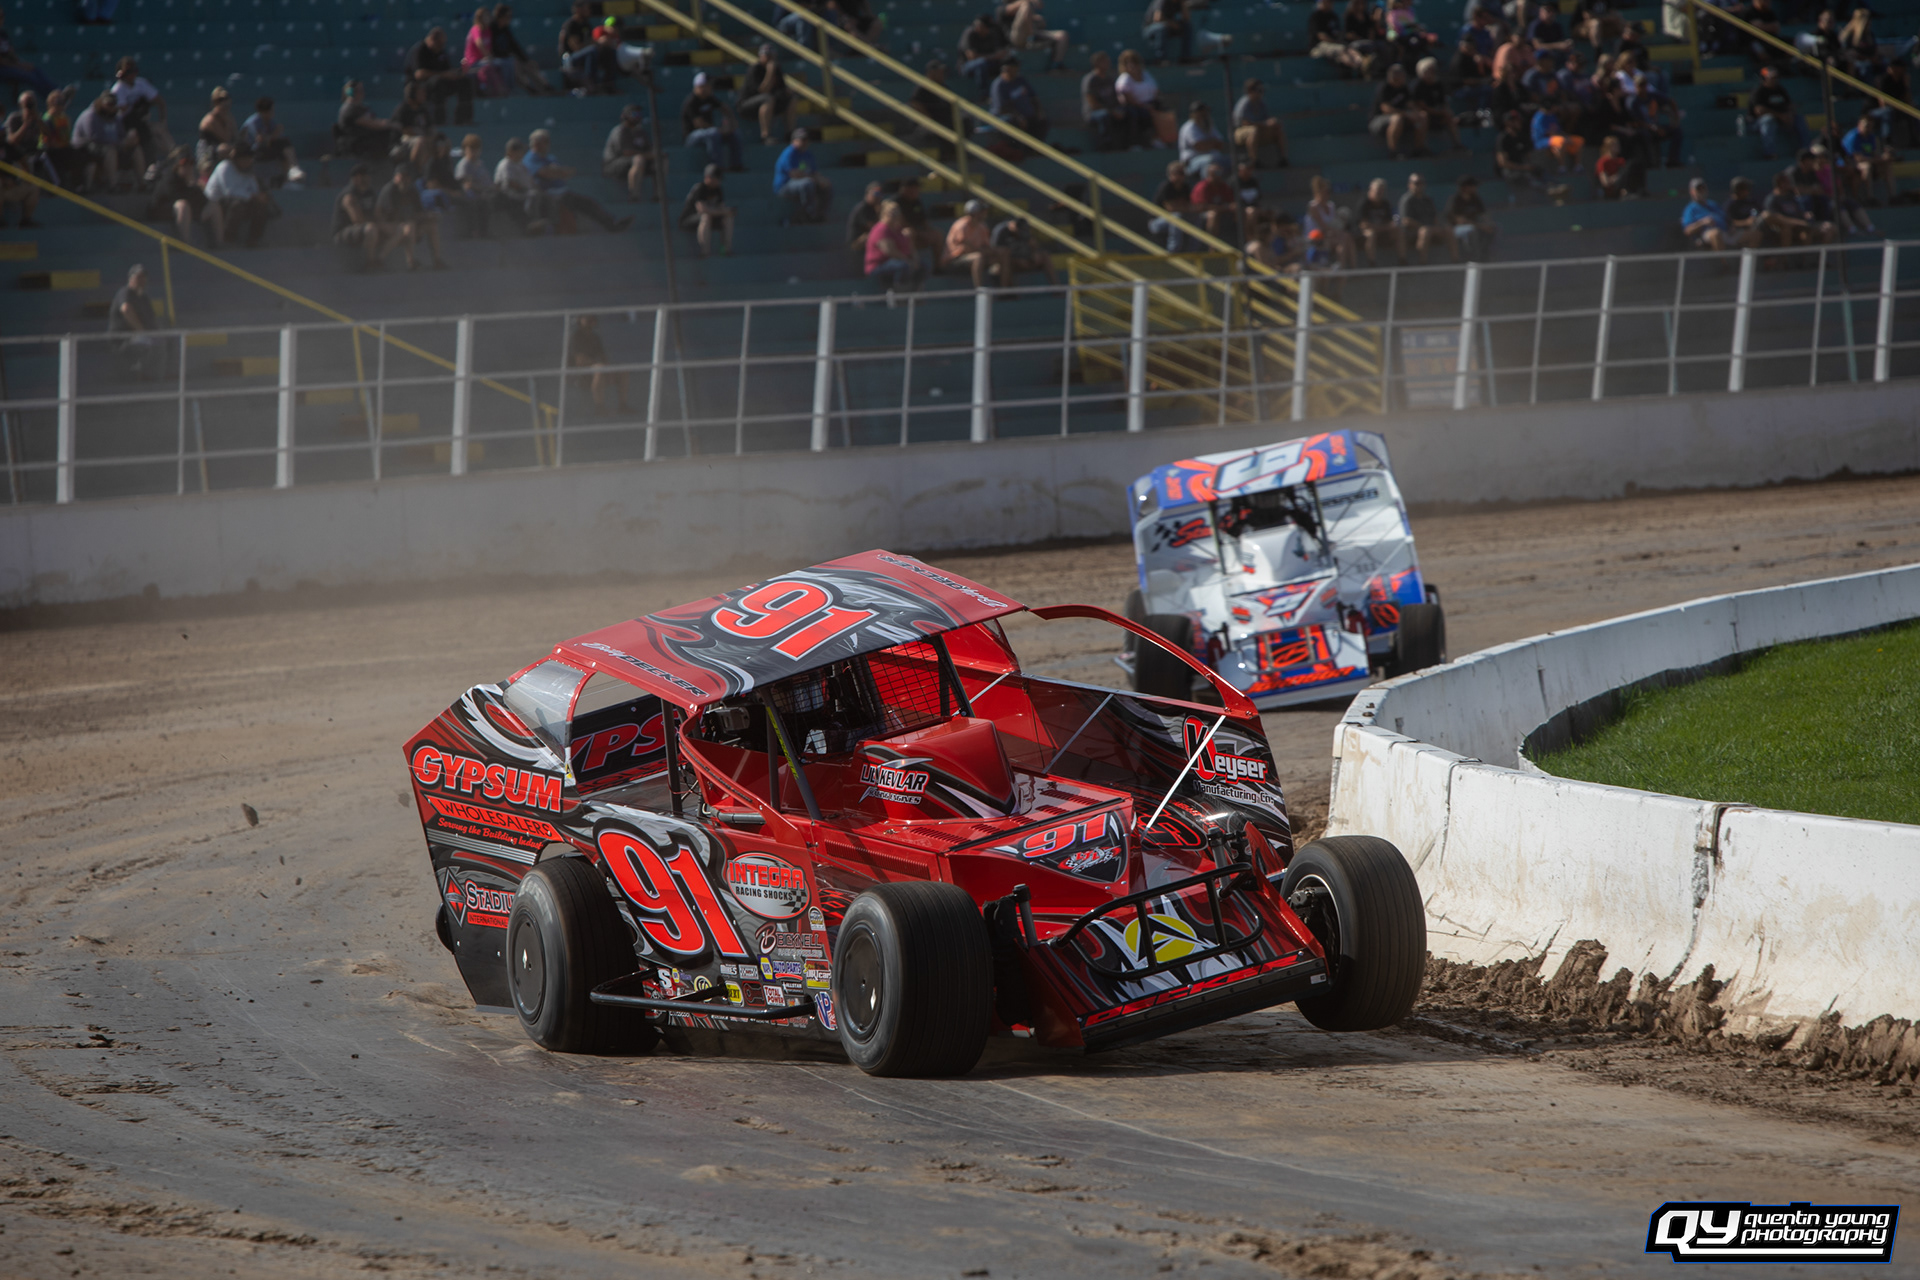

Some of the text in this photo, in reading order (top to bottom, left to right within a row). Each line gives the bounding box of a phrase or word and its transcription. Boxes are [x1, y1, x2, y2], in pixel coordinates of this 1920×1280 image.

[711, 580, 880, 661] 91
[616, 654, 711, 698] DECKER
[1186, 723, 1267, 781] Keyser
[412, 745, 562, 813] GYPSUM
[879, 767, 928, 791] KEVLAR
[1193, 780, 1257, 803] Manufacturing
[437, 817, 467, 834] Serving
[468, 822, 482, 836] the
[482, 827, 517, 846] Building
[438, 799, 553, 838] WHOLESALERS
[1023, 812, 1108, 859] 91
[597, 828, 750, 958] 91
[728, 861, 806, 889] INTEGRA
[736, 886, 793, 901] RACING SHOCKS
[764, 987, 781, 997] TOTAL
[768, 996, 784, 1005] POWER
[1084, 951, 1299, 1028] DECKER
